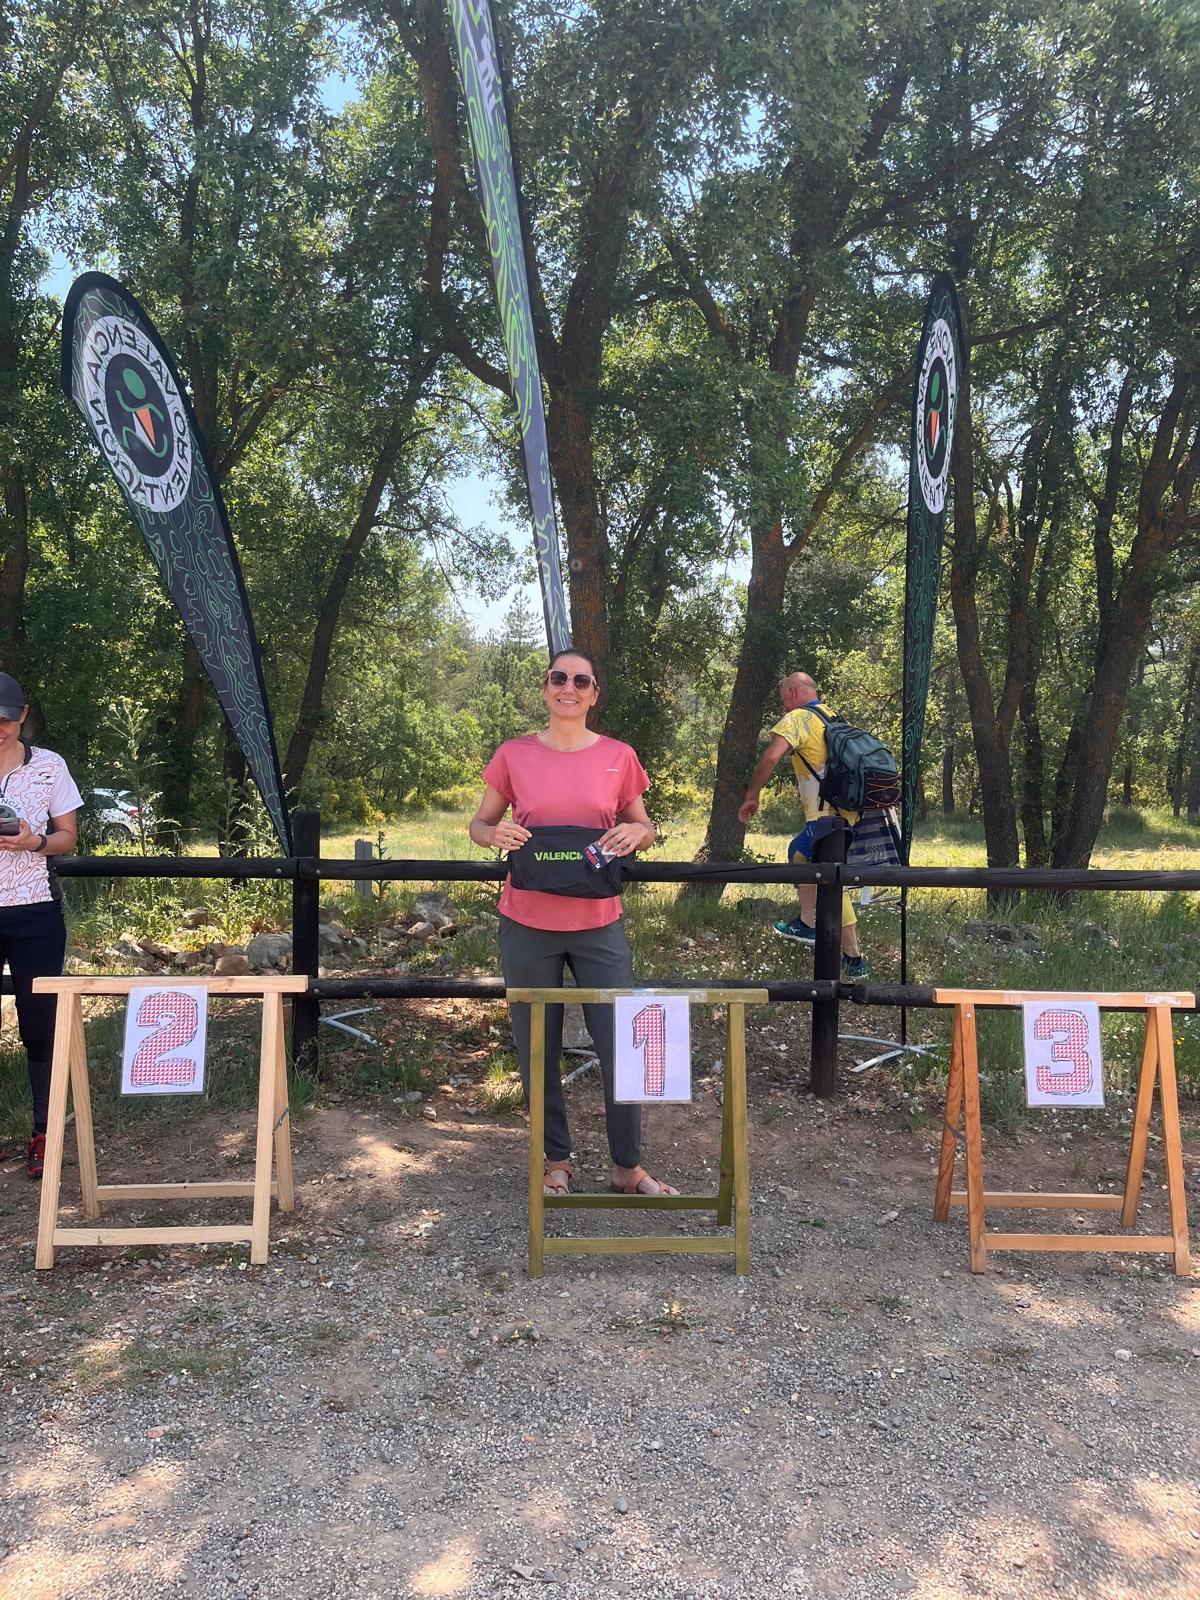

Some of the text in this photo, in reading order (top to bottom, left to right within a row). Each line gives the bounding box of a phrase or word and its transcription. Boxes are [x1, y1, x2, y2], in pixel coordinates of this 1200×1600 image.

[130, 991, 199, 1088] 2
[632, 1003, 665, 1096] 1
[1034, 1008, 1094, 1096] 3
